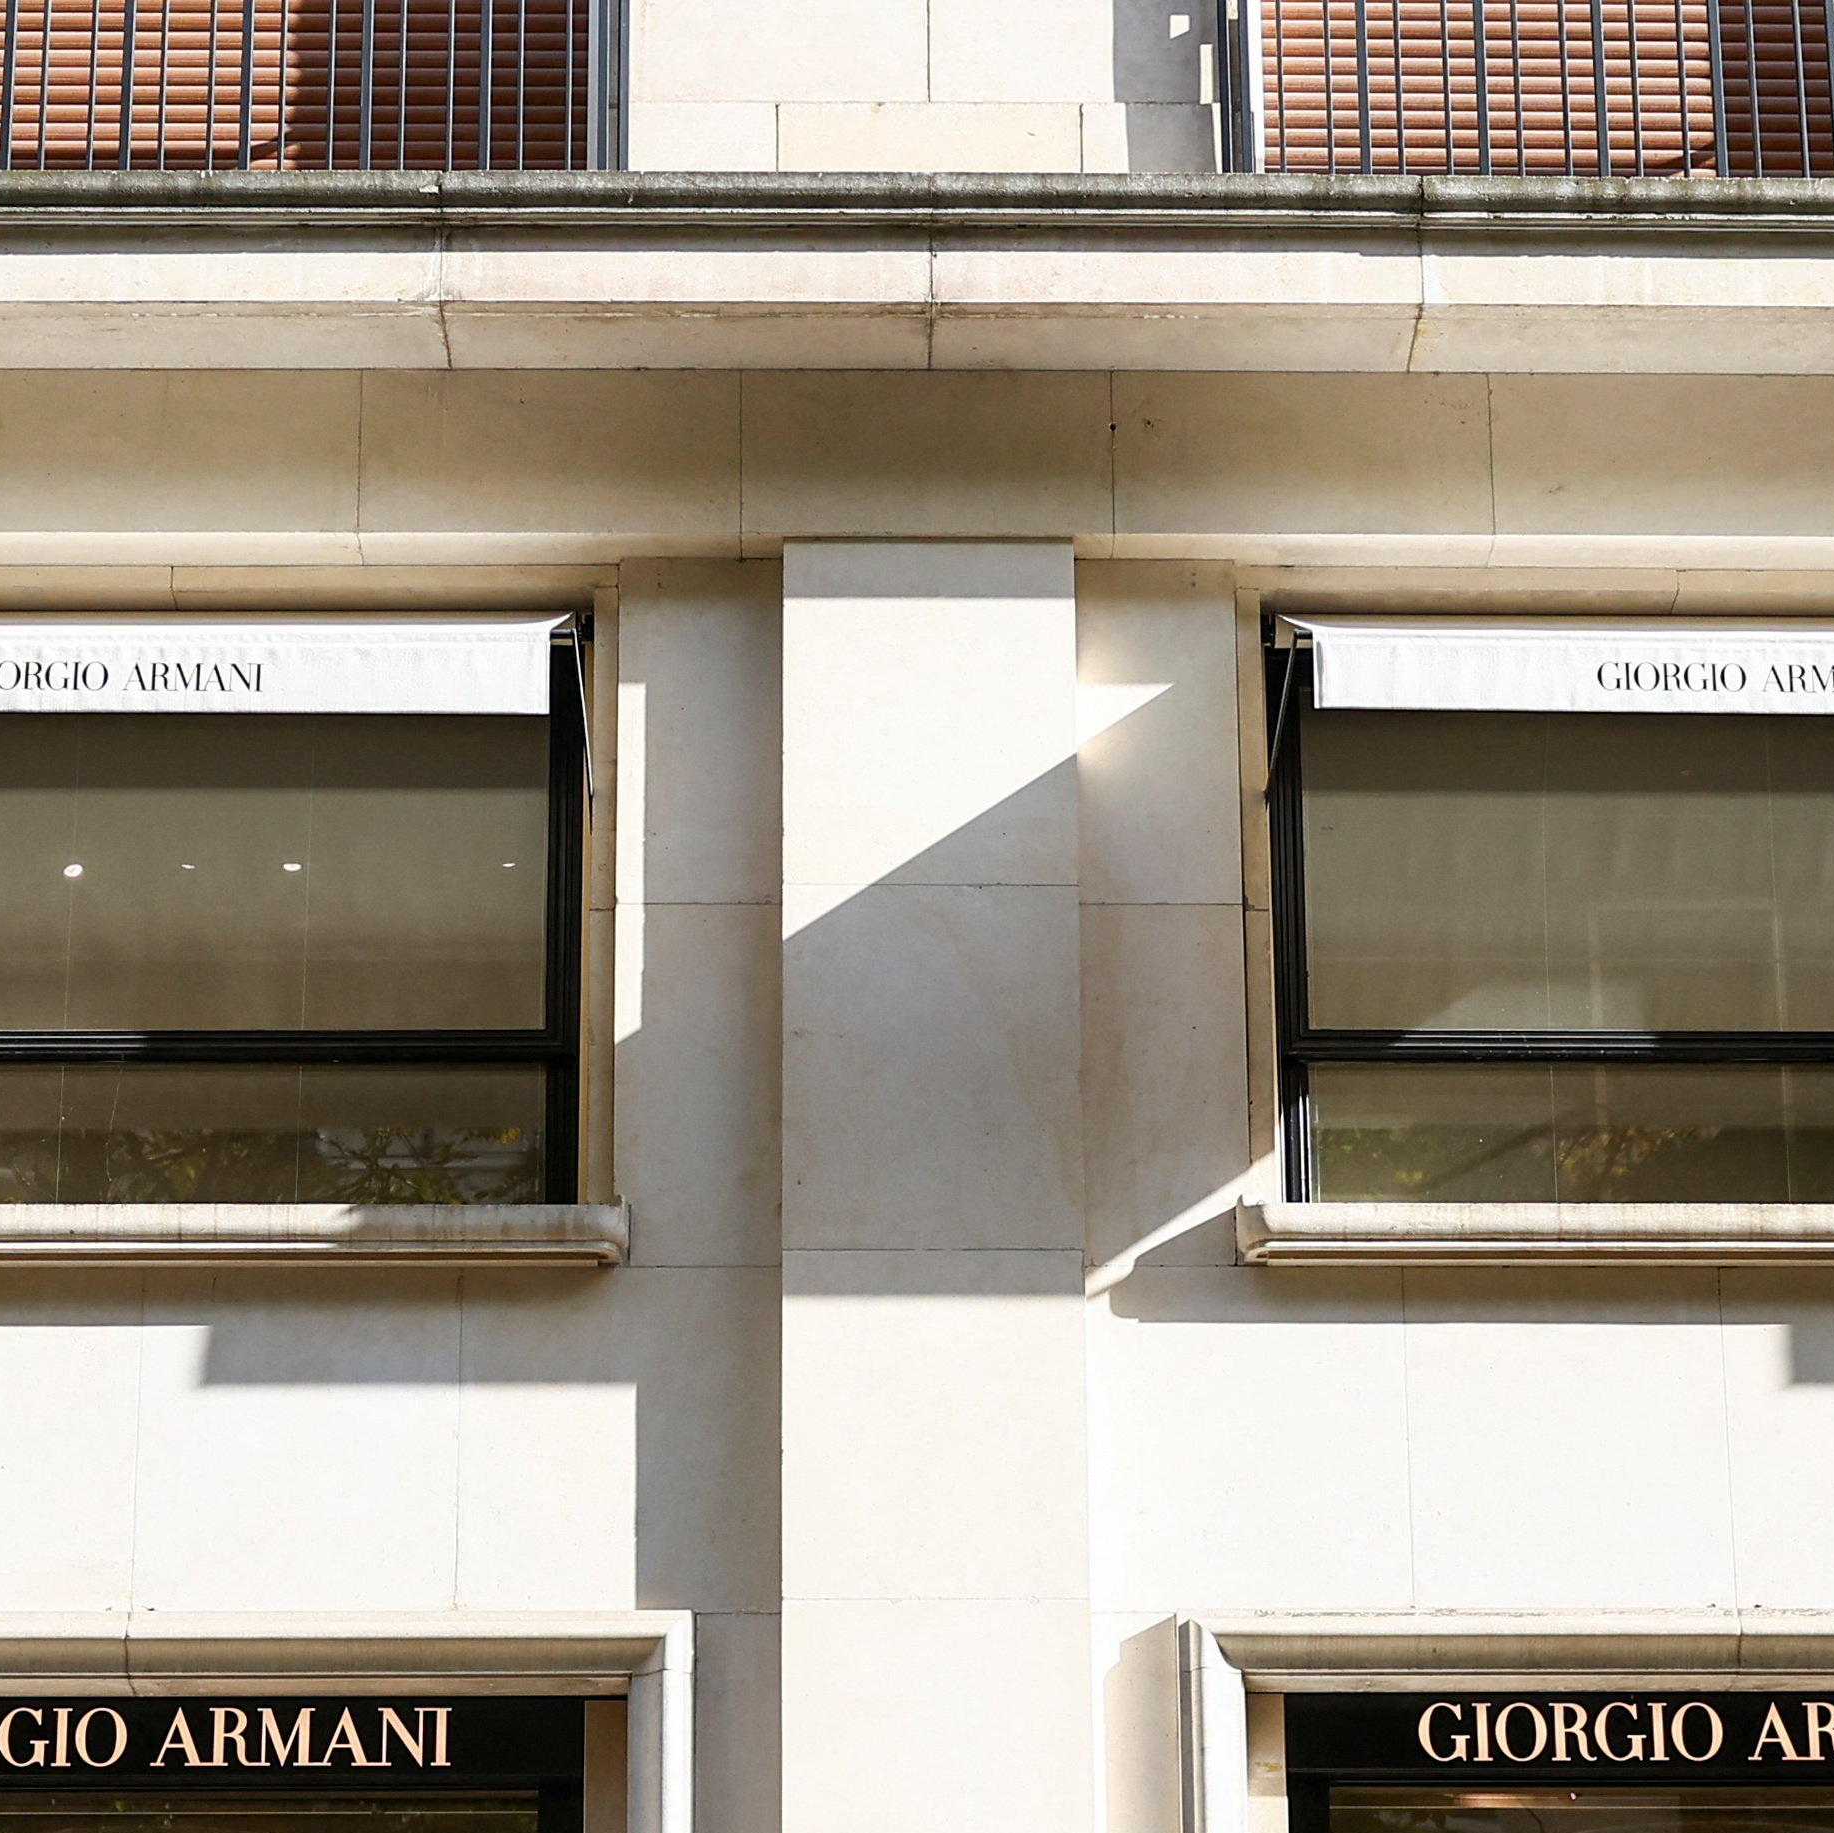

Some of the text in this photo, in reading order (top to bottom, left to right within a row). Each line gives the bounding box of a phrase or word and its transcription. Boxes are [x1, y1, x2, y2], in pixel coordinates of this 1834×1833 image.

[122, 661, 264, 693] ARMANI
[1596, 661, 1748, 693] GIORGIO
[149, 1706, 453, 1768] ARMANI
[1417, 1701, 1724, 1762] GIORGIO
